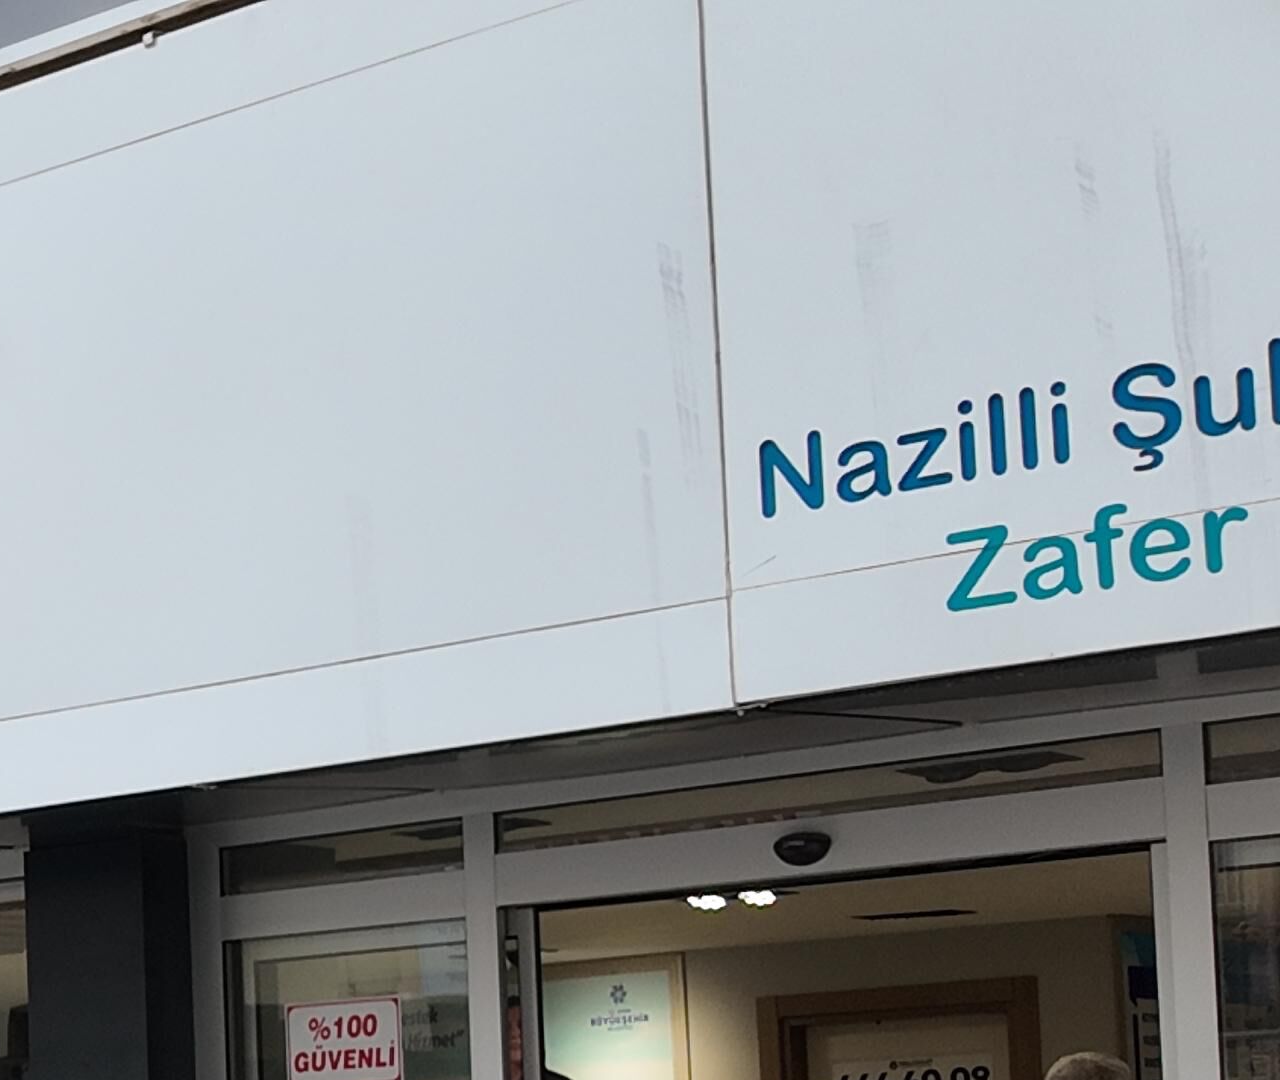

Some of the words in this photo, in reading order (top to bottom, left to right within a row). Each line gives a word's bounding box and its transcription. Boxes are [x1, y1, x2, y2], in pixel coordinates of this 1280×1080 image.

[758, 380, 1071, 518] Nazilli
[945, 502, 1249, 612] Zafer
[294, 1039, 395, 1073] GÜVENLİ
[308, 1013, 378, 1041] %100
